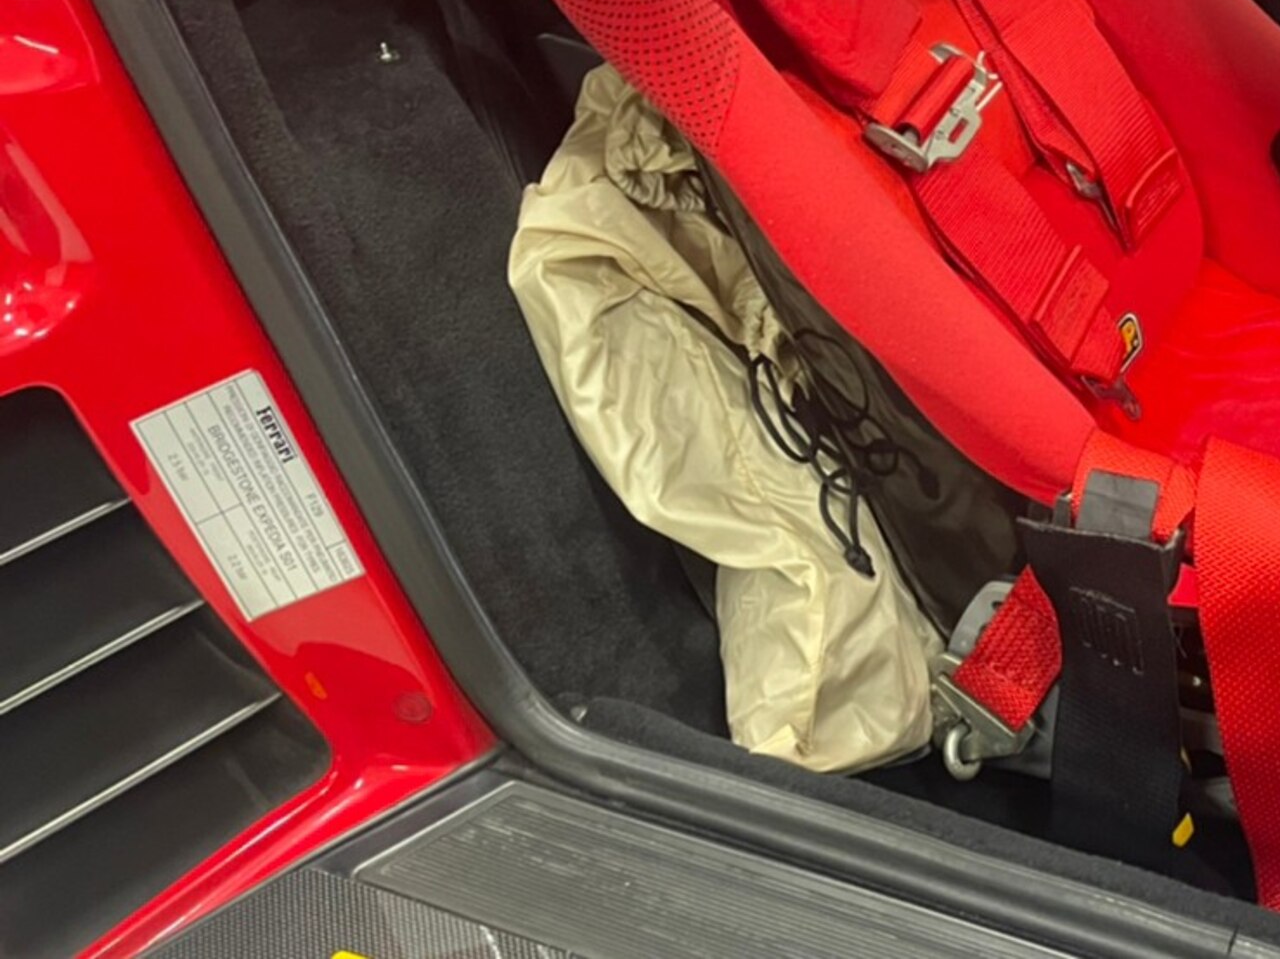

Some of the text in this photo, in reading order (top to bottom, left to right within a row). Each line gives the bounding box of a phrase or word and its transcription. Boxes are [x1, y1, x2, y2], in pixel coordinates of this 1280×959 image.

[254, 404, 298, 464] Ferrari
[206, 423, 261, 506] BRIDGESTONE
[251, 503, 286, 552] EXPEDIA
